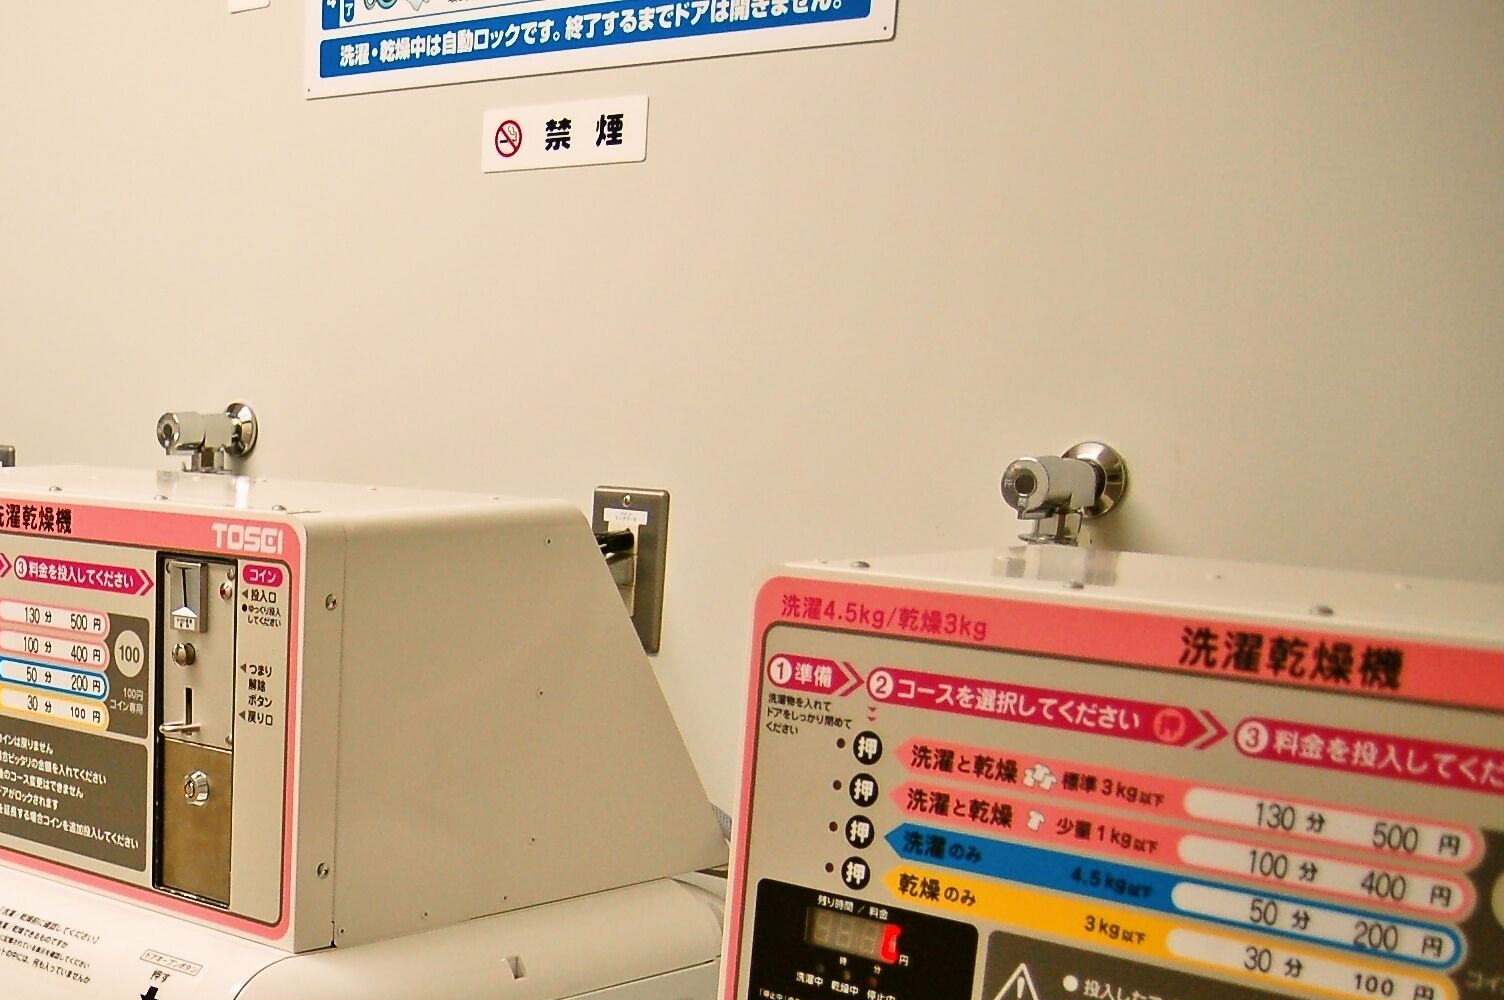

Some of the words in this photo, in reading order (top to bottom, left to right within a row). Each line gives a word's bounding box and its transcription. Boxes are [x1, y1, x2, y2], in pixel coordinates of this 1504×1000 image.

[544, 114, 624, 151] 禁煙
[211, 522, 284, 555] TOSEI
[249, 568, 277, 584] コイン
[250, 589, 277, 604] 投入口
[24, 606, 40, 624] 130
[70, 613, 88, 631] 500
[93, 618, 101, 631] 円
[780, 594, 988, 641] 洗濯4.5kg/乾燥3kg
[23, 635, 39, 653] 100
[70, 644, 88, 662] 400
[93, 649, 101, 662] 円
[118, 644, 141, 664] 100
[1177, 625, 1405, 691] 洗濯乾燥機
[26, 666, 38, 683] 50
[71, 674, 89, 692] 200
[93, 680, 101, 693] 円
[248, 664, 273, 677] つまり
[27, 695, 39, 712] 30
[70, 706, 87, 720] 100
[93, 710, 101, 724] 円
[247, 693, 273, 708] ボタン
[247, 710, 273, 726] 戻り口
[765, 722, 799, 736] ください
[910, 743, 1018, 785] 洗濯と乾燥
[906, 786, 1013, 829] 洗濯と乾燥
[903, 829, 982, 863] 洗濯のみ
[1256, 802, 1296, 832] 130
[1305, 812, 1326, 834] 分
[1372, 822, 1419, 855] 500
[1439, 834, 1461, 857] 円
[898, 871, 977, 907] 乾燥のみ
[1249, 849, 1289, 880] 100
[1298, 862, 1318, 883] 分
[1361, 867, 1407, 901] 400
[1430, 884, 1452, 908] 円
[1249, 899, 1278, 927] 50
[1292, 909, 1311, 931] 分
[1353, 921, 1398, 953] 200
[1422, 935, 1444, 959] 円
[1244, 946, 1273, 974] 30
[1284, 957, 1304, 978] 分
[1354, 972, 1395, 998] 100
